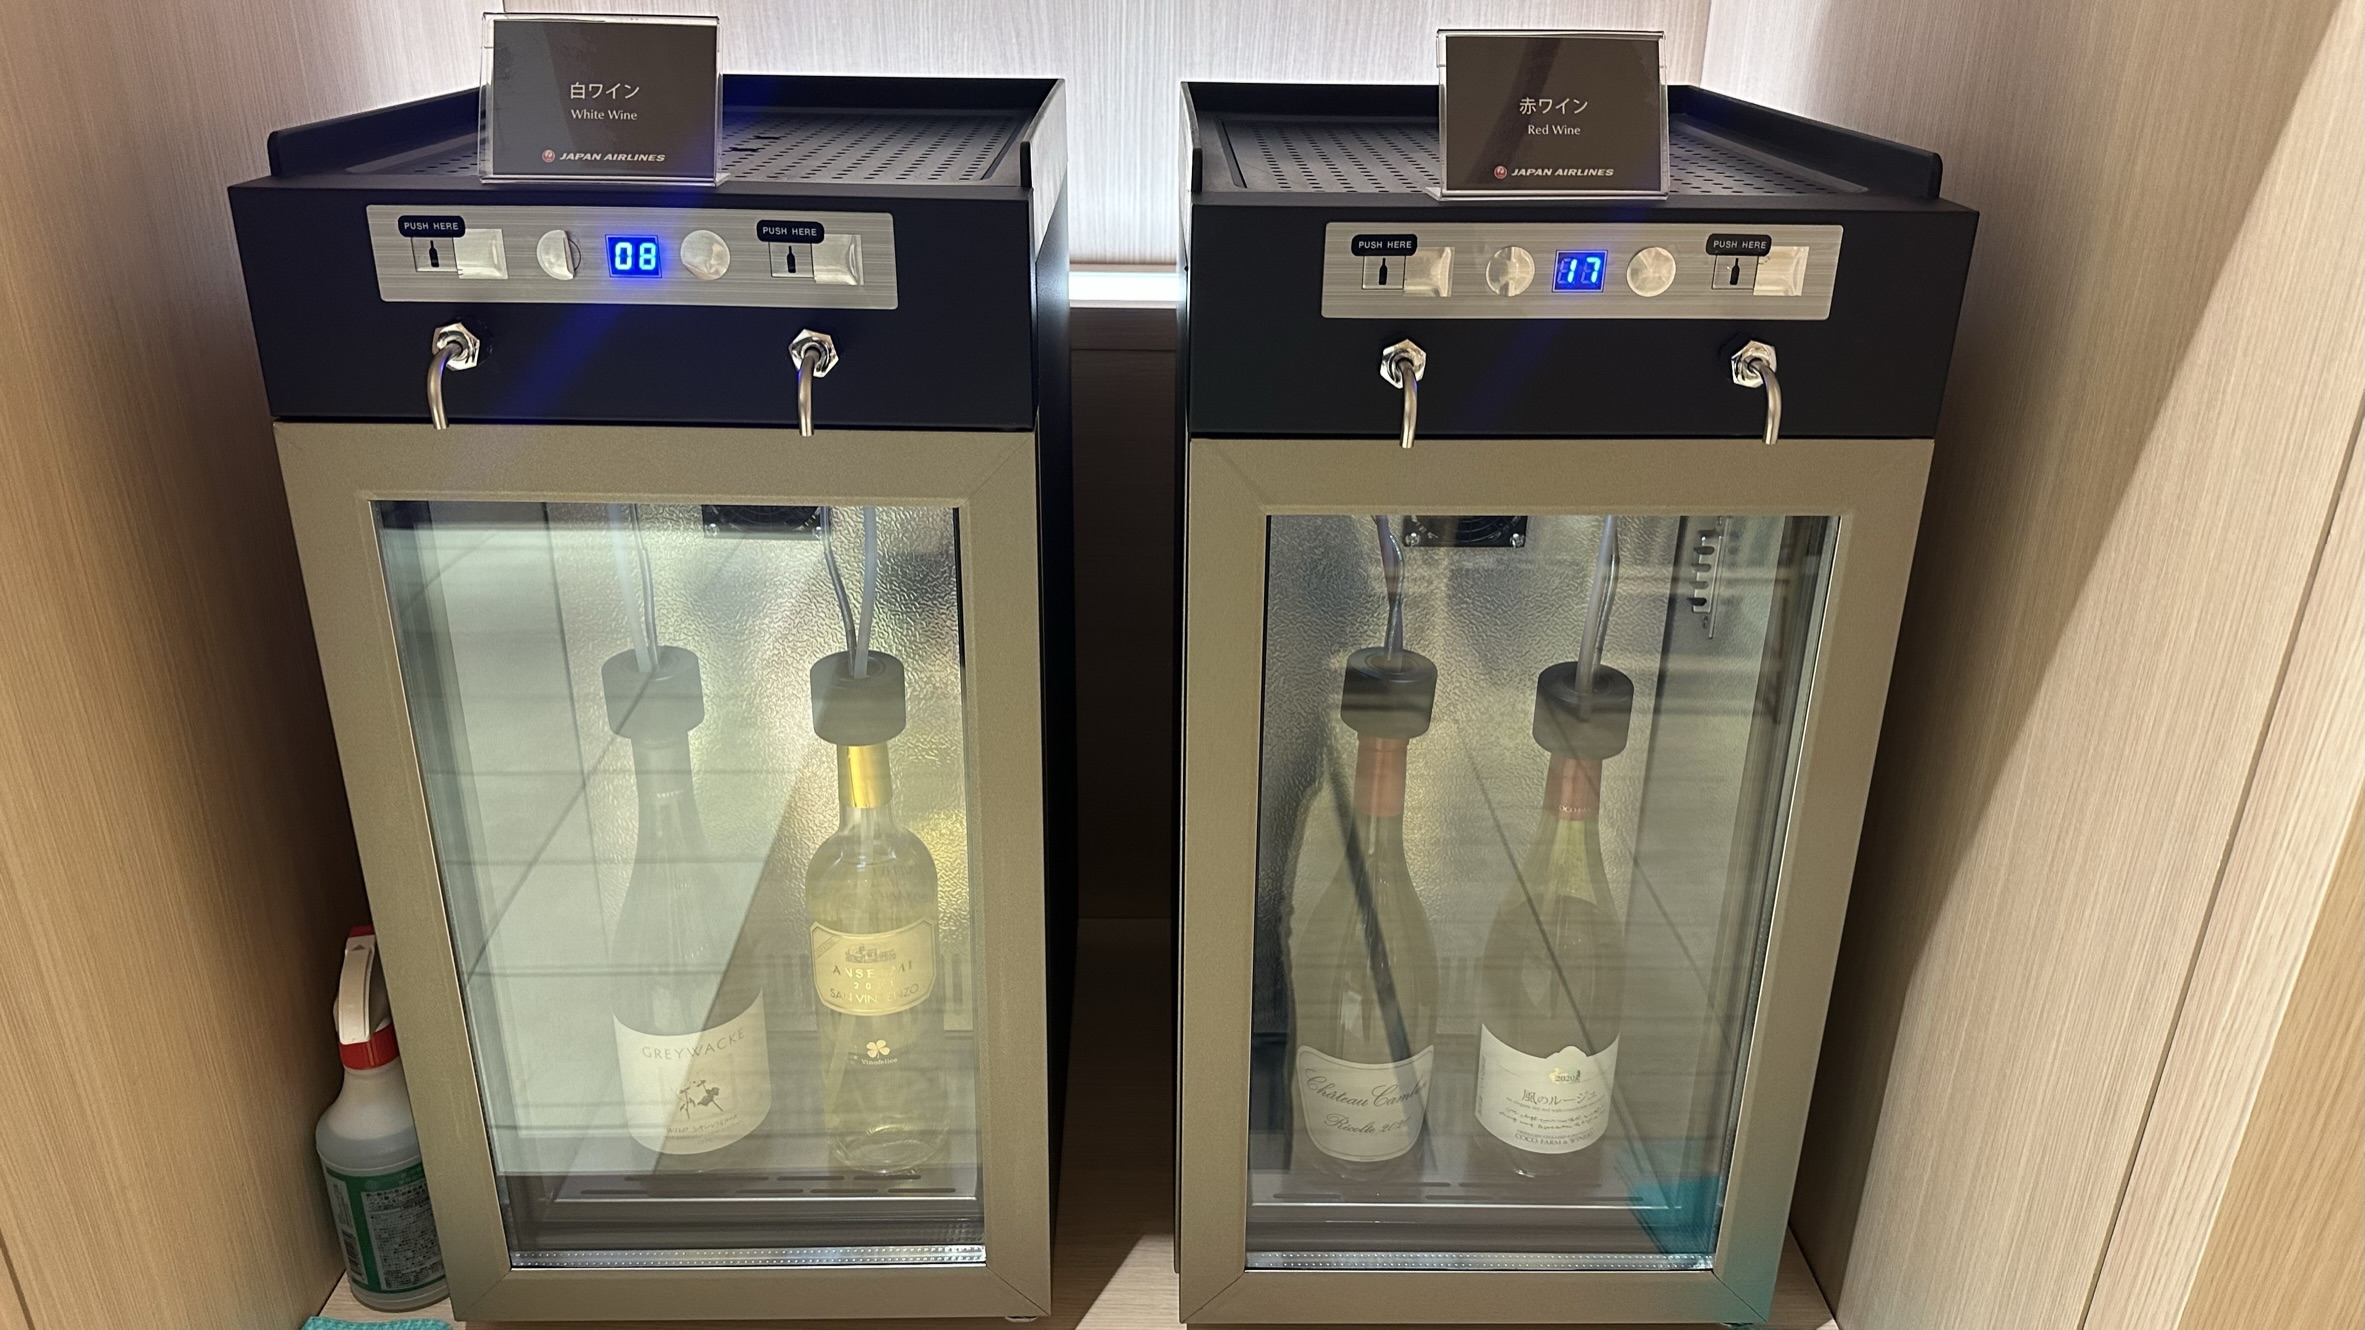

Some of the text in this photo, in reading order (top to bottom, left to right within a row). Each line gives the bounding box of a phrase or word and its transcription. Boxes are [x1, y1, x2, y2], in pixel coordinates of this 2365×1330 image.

[570, 82, 640, 100] 白ワイン
[1519, 97, 1589, 115] 赤ワイン
[570, 109, 638, 120] White Wine
[1527, 124, 1581, 135] Red Wine
[559, 152, 666, 162] JAPAN AIRLINES
[1511, 168, 1615, 177] JAPAN AIRLINES
[403, 221, 460, 232] PUSH HERE
[761, 226, 818, 238] PUSH HERE
[1357, 240, 1413, 250] PUSH HERE
[1712, 239, 1768, 250] PUSH HERE
[614, 241, 658, 272] 08
[1564, 257, 1600, 284] 17
[641, 1027, 745, 1061] GREYWACKE
[1305, 1068, 1369, 1107] Château
[1521, 1089, 1599, 1105] 風のルージュ
